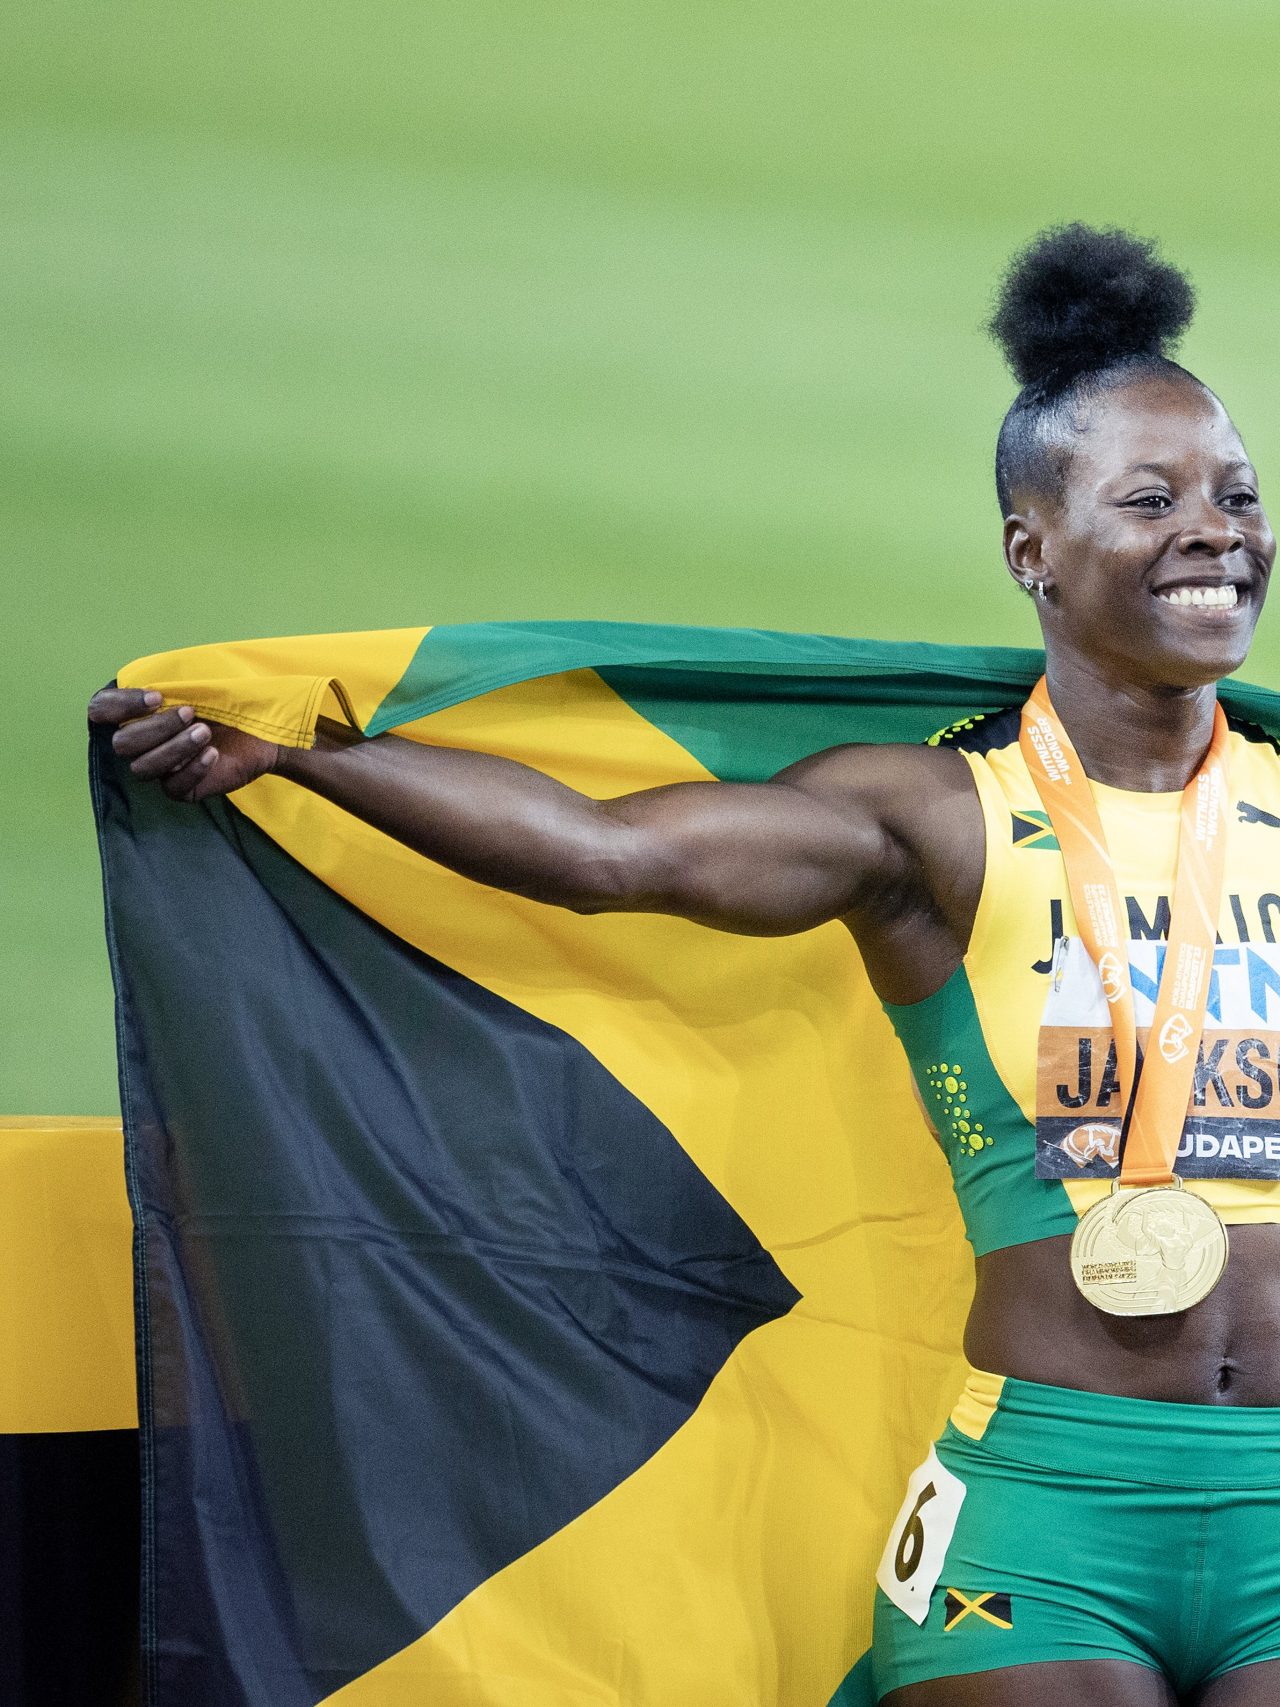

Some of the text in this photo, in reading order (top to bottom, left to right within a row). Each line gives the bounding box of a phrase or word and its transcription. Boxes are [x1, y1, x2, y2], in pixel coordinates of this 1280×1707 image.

[1027, 725, 1061, 782] WITNESS
[1037, 716, 1070, 774] WONDER
[1196, 774, 1210, 841] WITNESS
[894, 1480, 938, 1583] 6
